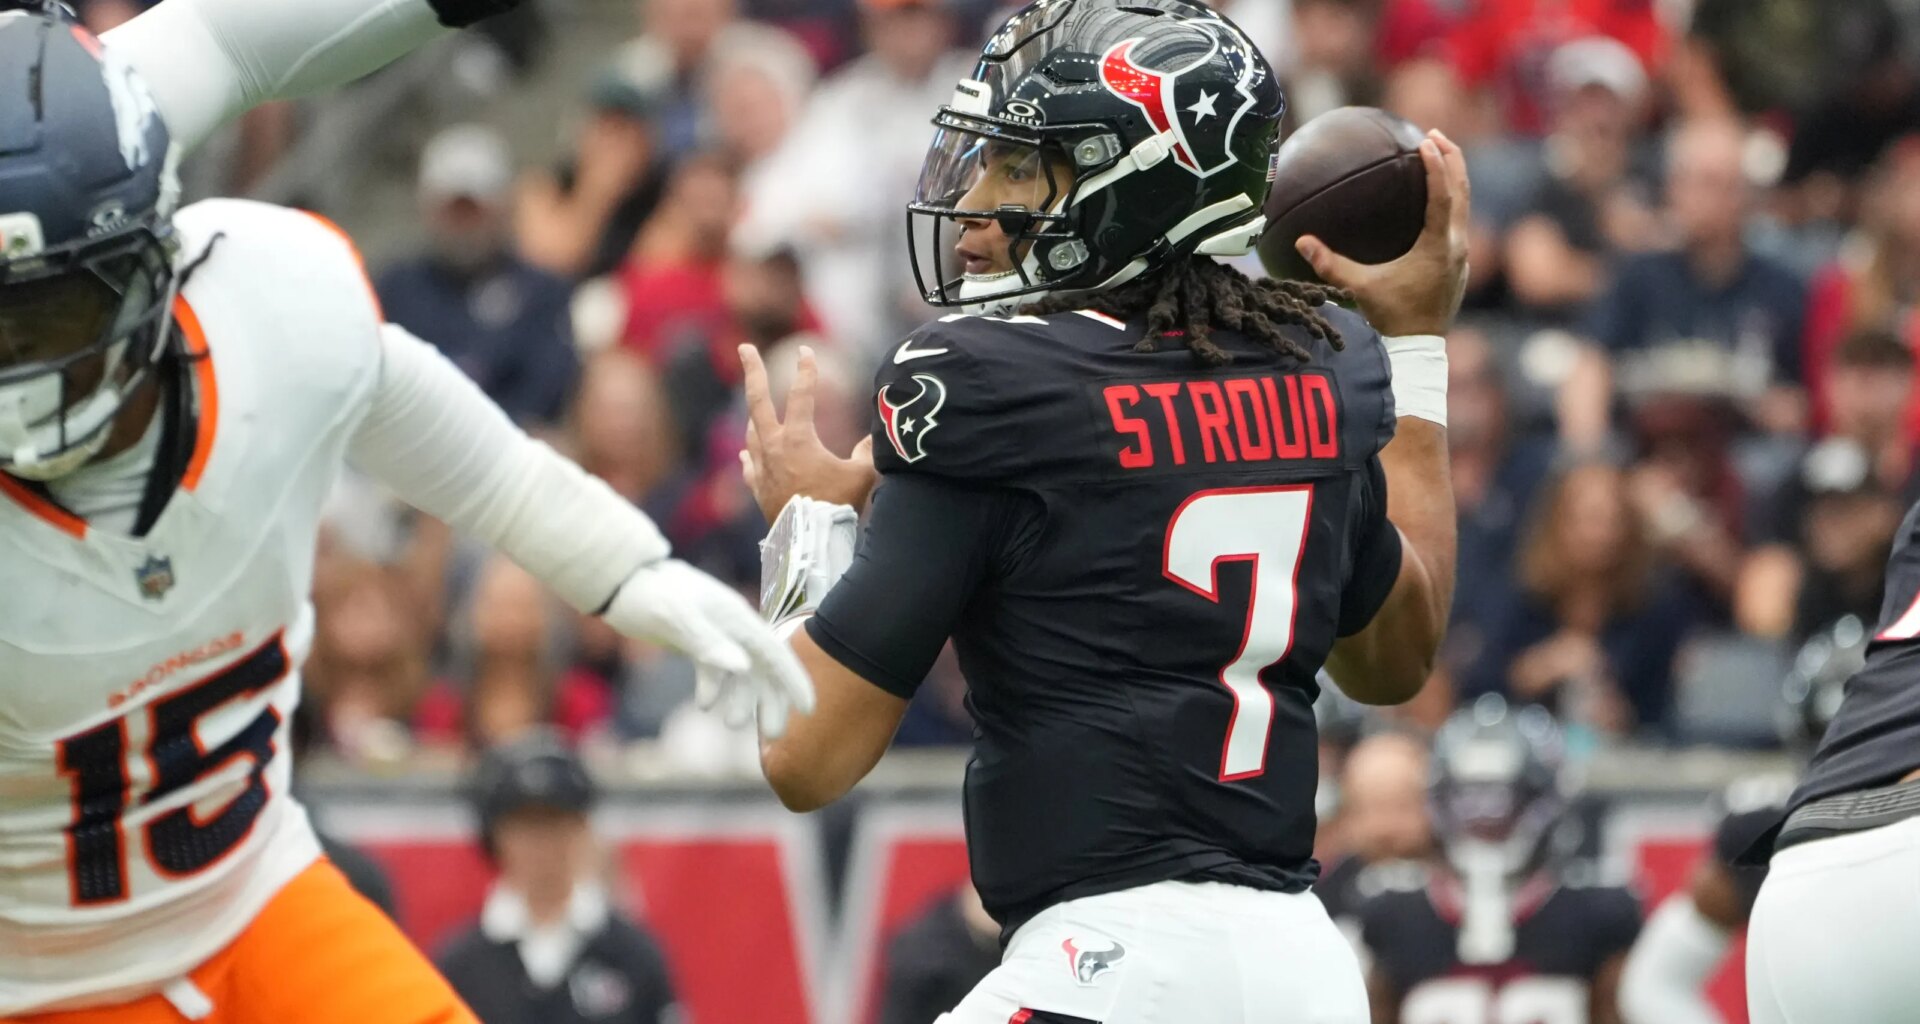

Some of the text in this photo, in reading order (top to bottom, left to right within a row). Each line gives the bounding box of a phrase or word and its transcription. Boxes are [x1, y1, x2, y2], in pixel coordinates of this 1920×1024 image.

[998, 112, 1041, 126] OAKLEY
[1103, 374, 1339, 469] STROUD
[1162, 483, 1314, 782] 7
[54, 625, 289, 908] 15
